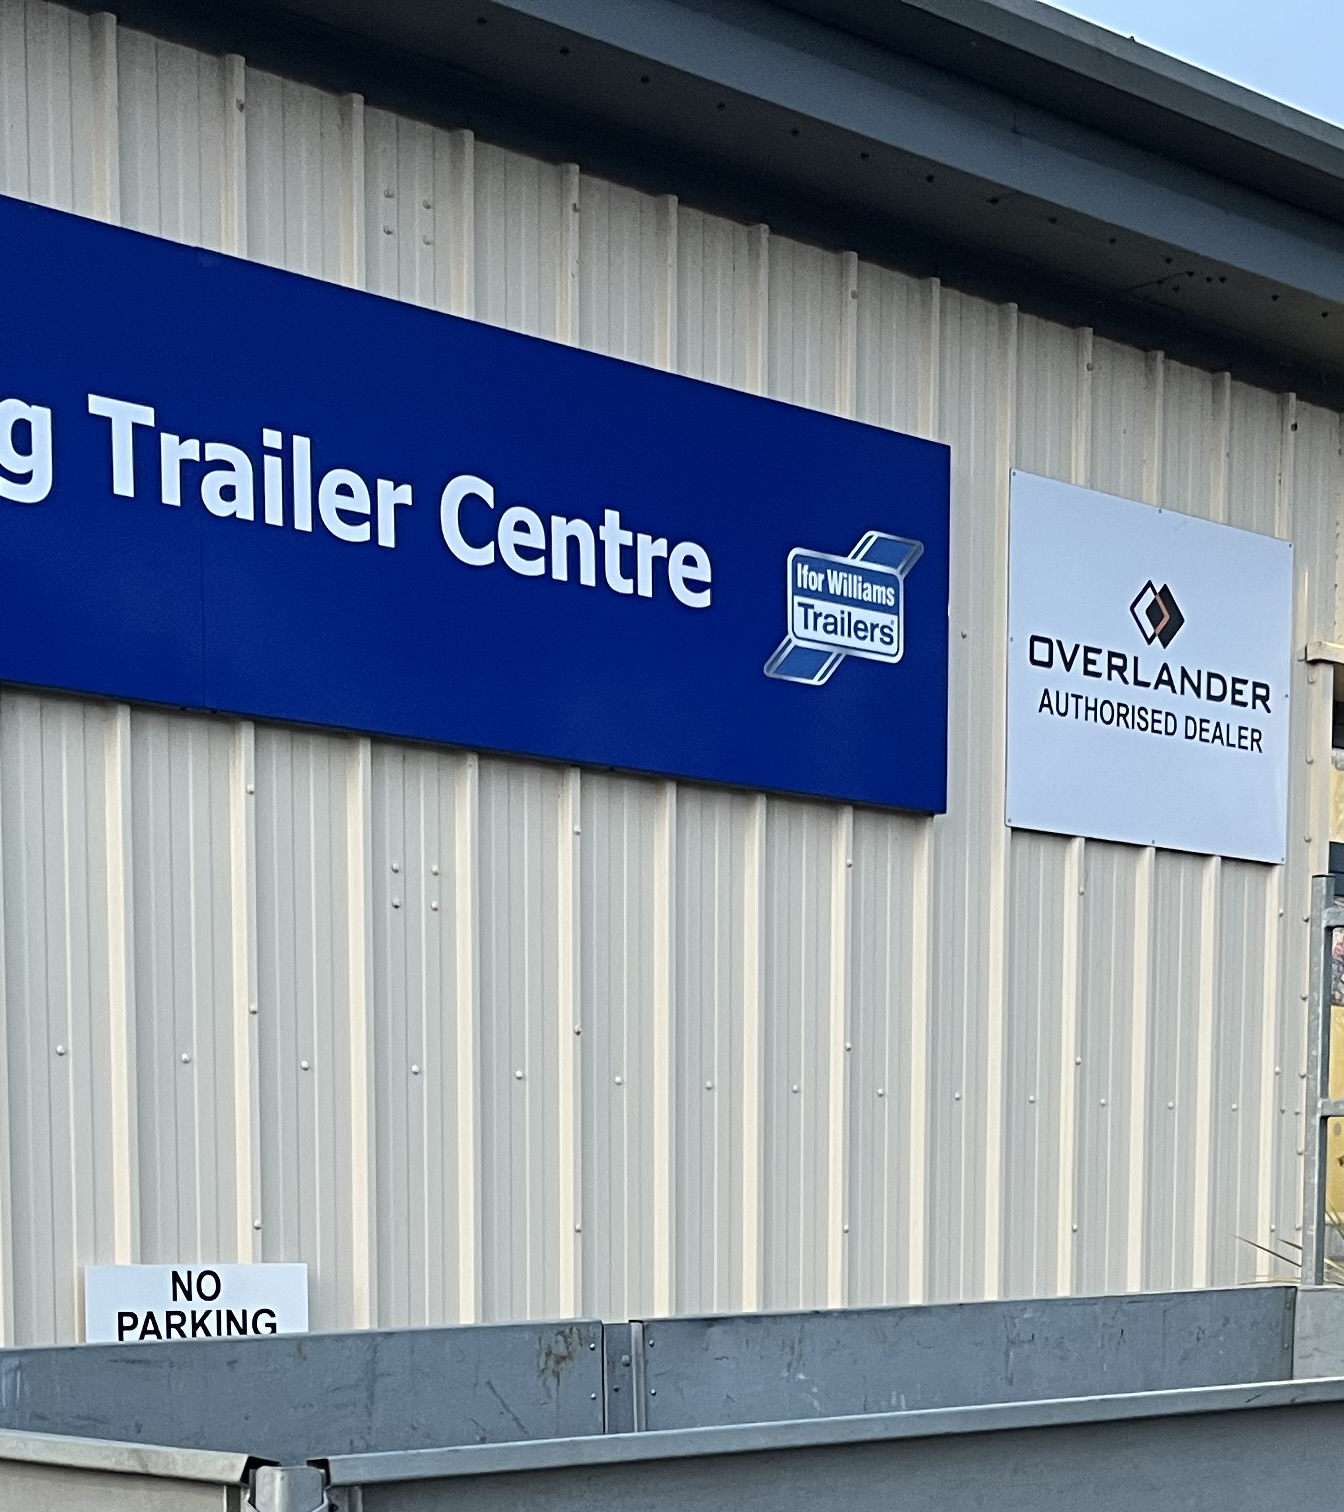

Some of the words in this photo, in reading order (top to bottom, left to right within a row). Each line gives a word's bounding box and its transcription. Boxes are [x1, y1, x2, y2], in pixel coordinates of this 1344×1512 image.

[87, 393, 412, 548] Trailer
[439, 474, 713, 609] Centre
[797, 562, 825, 593] Ifor
[826, 568, 896, 608] Williams
[797, 601, 895, 646] Trailers
[1029, 633, 1272, 714] OVERLANDER
[1038, 687, 1178, 737] AUTHORISED
[1184, 715, 1264, 754] DEALER
[171, 1269, 222, 1302] NO
[117, 1308, 278, 1342] PARKING
